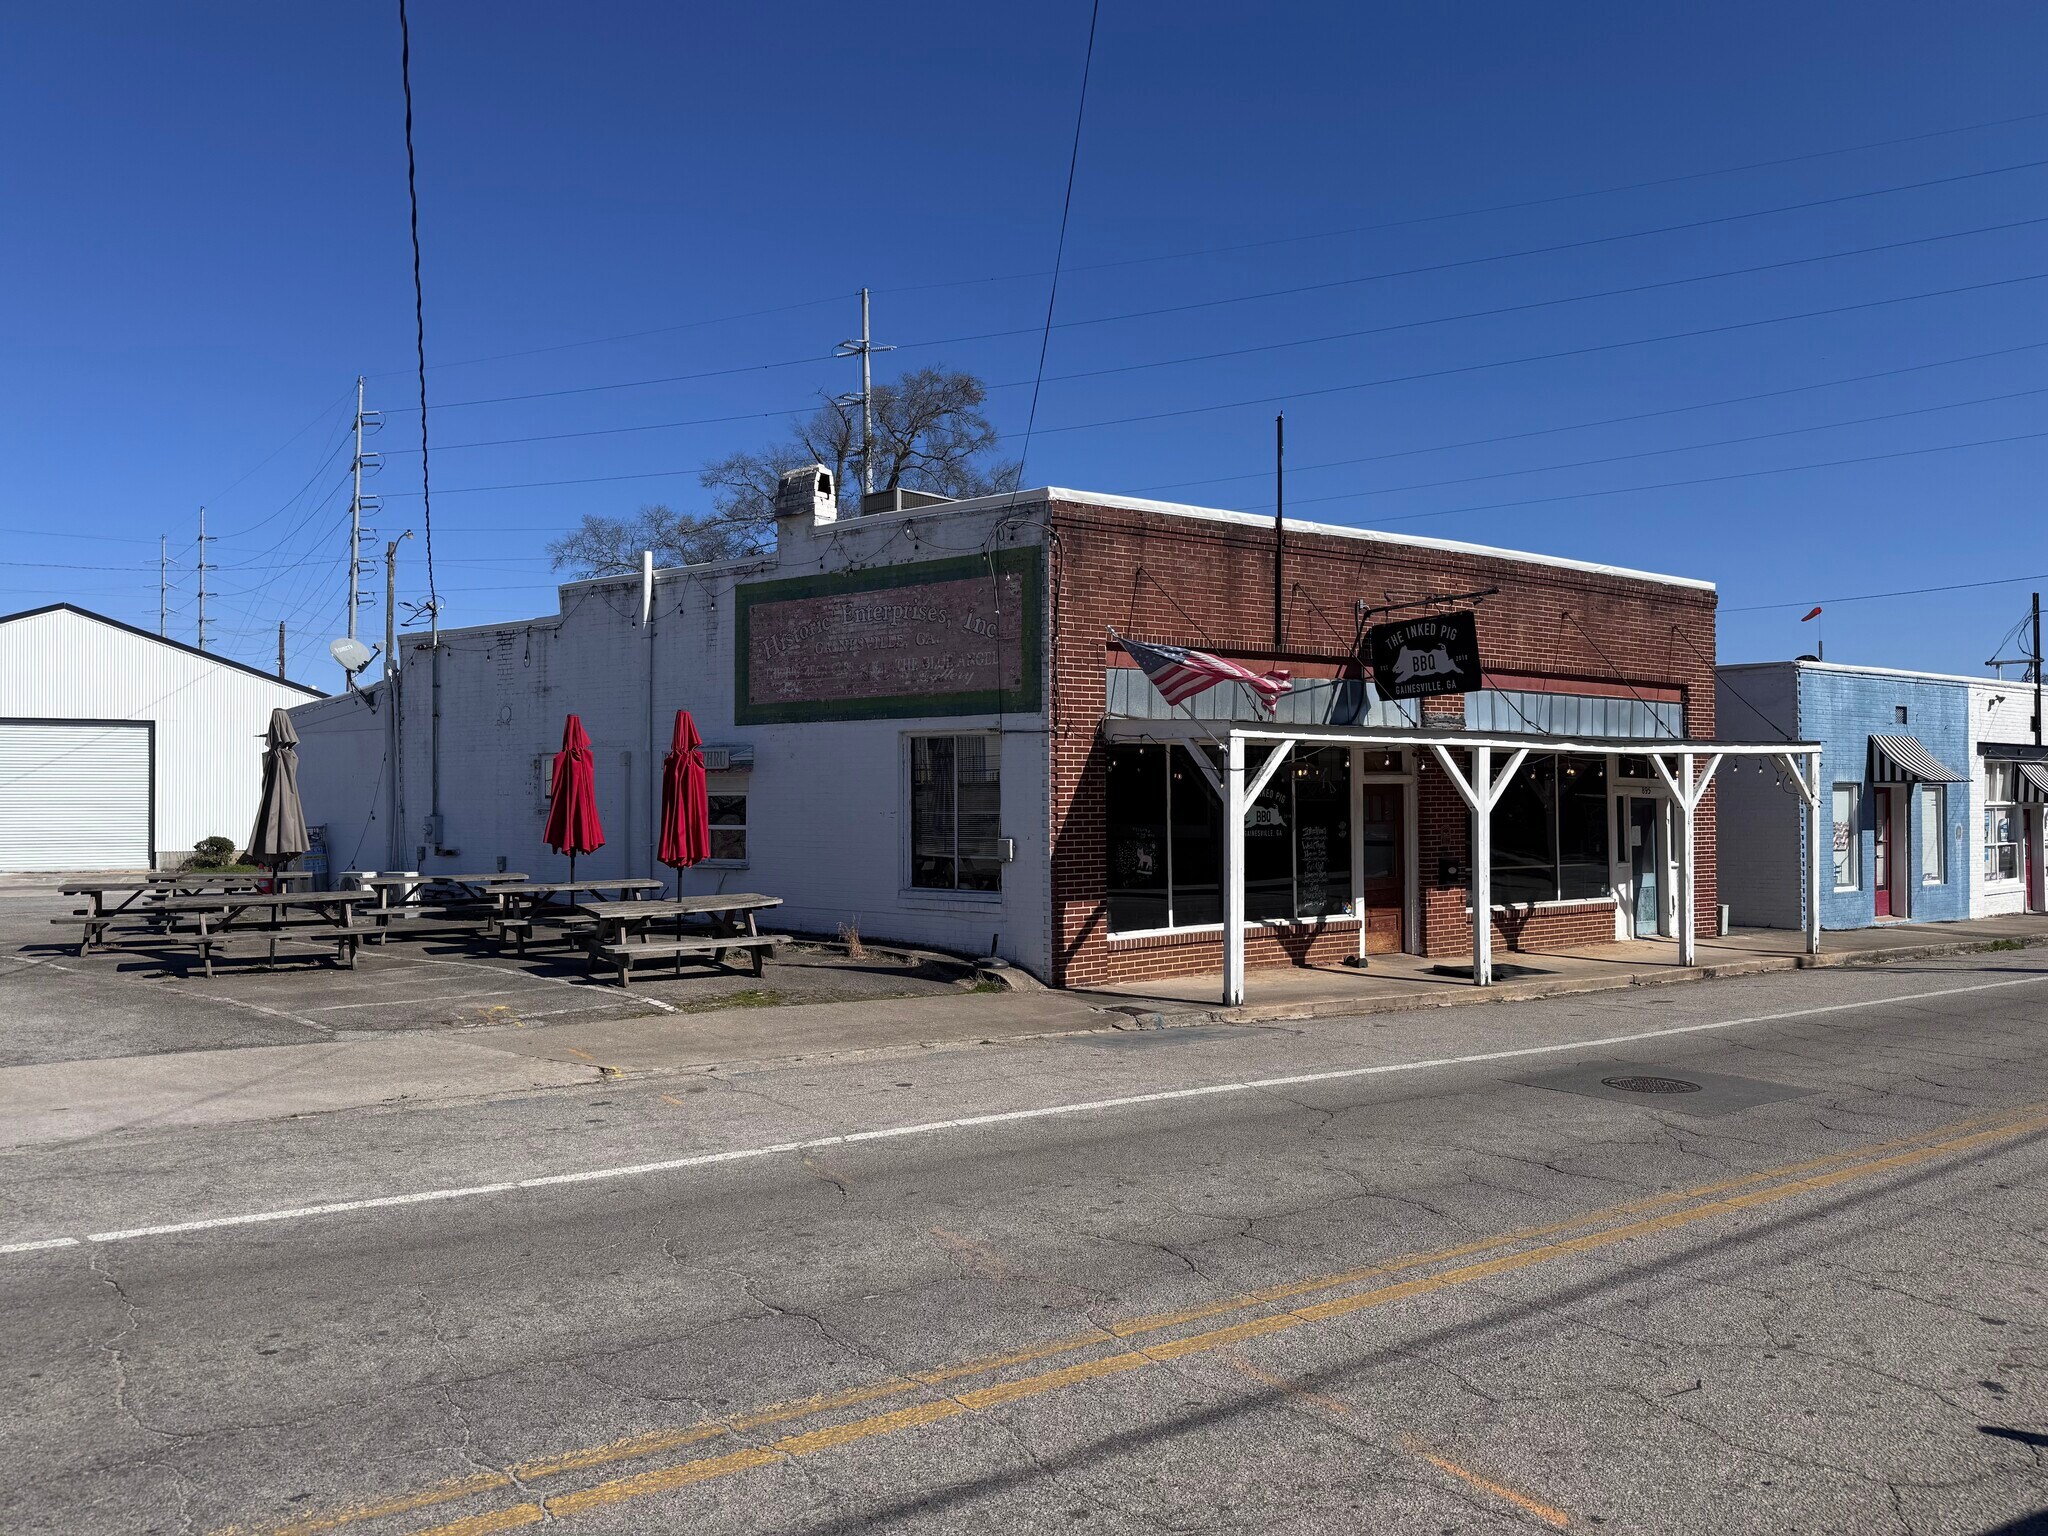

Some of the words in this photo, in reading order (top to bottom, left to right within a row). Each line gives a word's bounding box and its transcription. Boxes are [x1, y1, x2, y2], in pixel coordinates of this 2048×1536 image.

[762, 616, 830, 660] Historic
[841, 598, 952, 629] Enterprises,
[1385, 631, 1404, 650] THE
[1406, 623, 1436, 639] INKED
[1440, 625, 1457, 641] PIG
[1412, 654, 1436, 672] BBQ
[1395, 681, 1444, 695] GAINESVILLE,
[1446, 680, 1457, 690] GA
[1275, 791, 1286, 804] PIG
[1641, 786, 1651, 794] 895
[1256, 810, 1271, 823] BBQ
